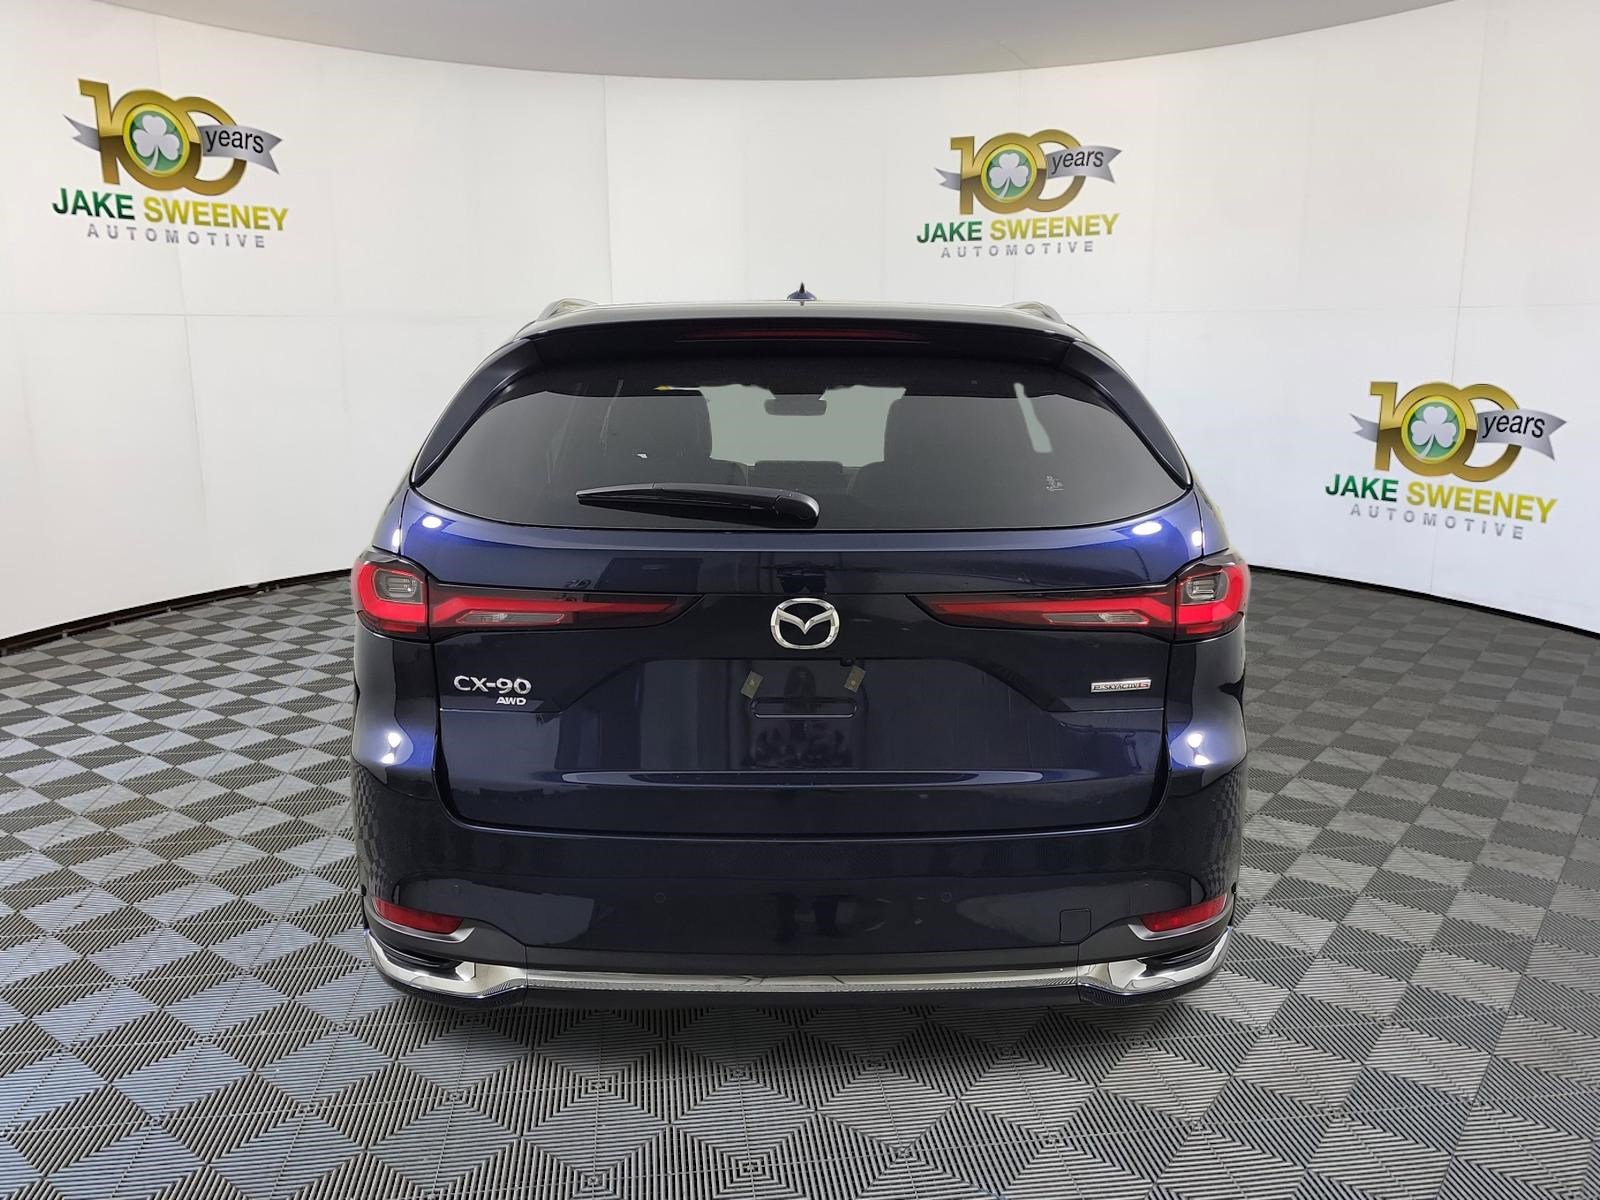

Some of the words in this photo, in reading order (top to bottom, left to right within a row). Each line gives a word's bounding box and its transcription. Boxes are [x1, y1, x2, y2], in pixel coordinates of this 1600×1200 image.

[78, 78, 247, 196] 100
[205, 129, 264, 153] years
[950, 128, 1087, 215] 100
[1051, 149, 1104, 175] years
[52, 187, 135, 220] JAKE
[143, 196, 288, 231] SWEENEY
[87, 223, 265, 248] AUTOMOTIVE
[916, 221, 983, 244] JAKE
[989, 213, 1120, 241] SWEENEY
[940, 240, 1094, 259] AUTOMOTIVE
[1369, 381, 1522, 482] 100
[1481, 414, 1545, 438] years
[1325, 473, 1399, 502] JAKE
[1406, 481, 1558, 523] SWEENEY
[1350, 503, 1525, 540] AUTOMOTIVE
[453, 675, 532, 695] CX-90
[496, 696, 527, 705] AWD
